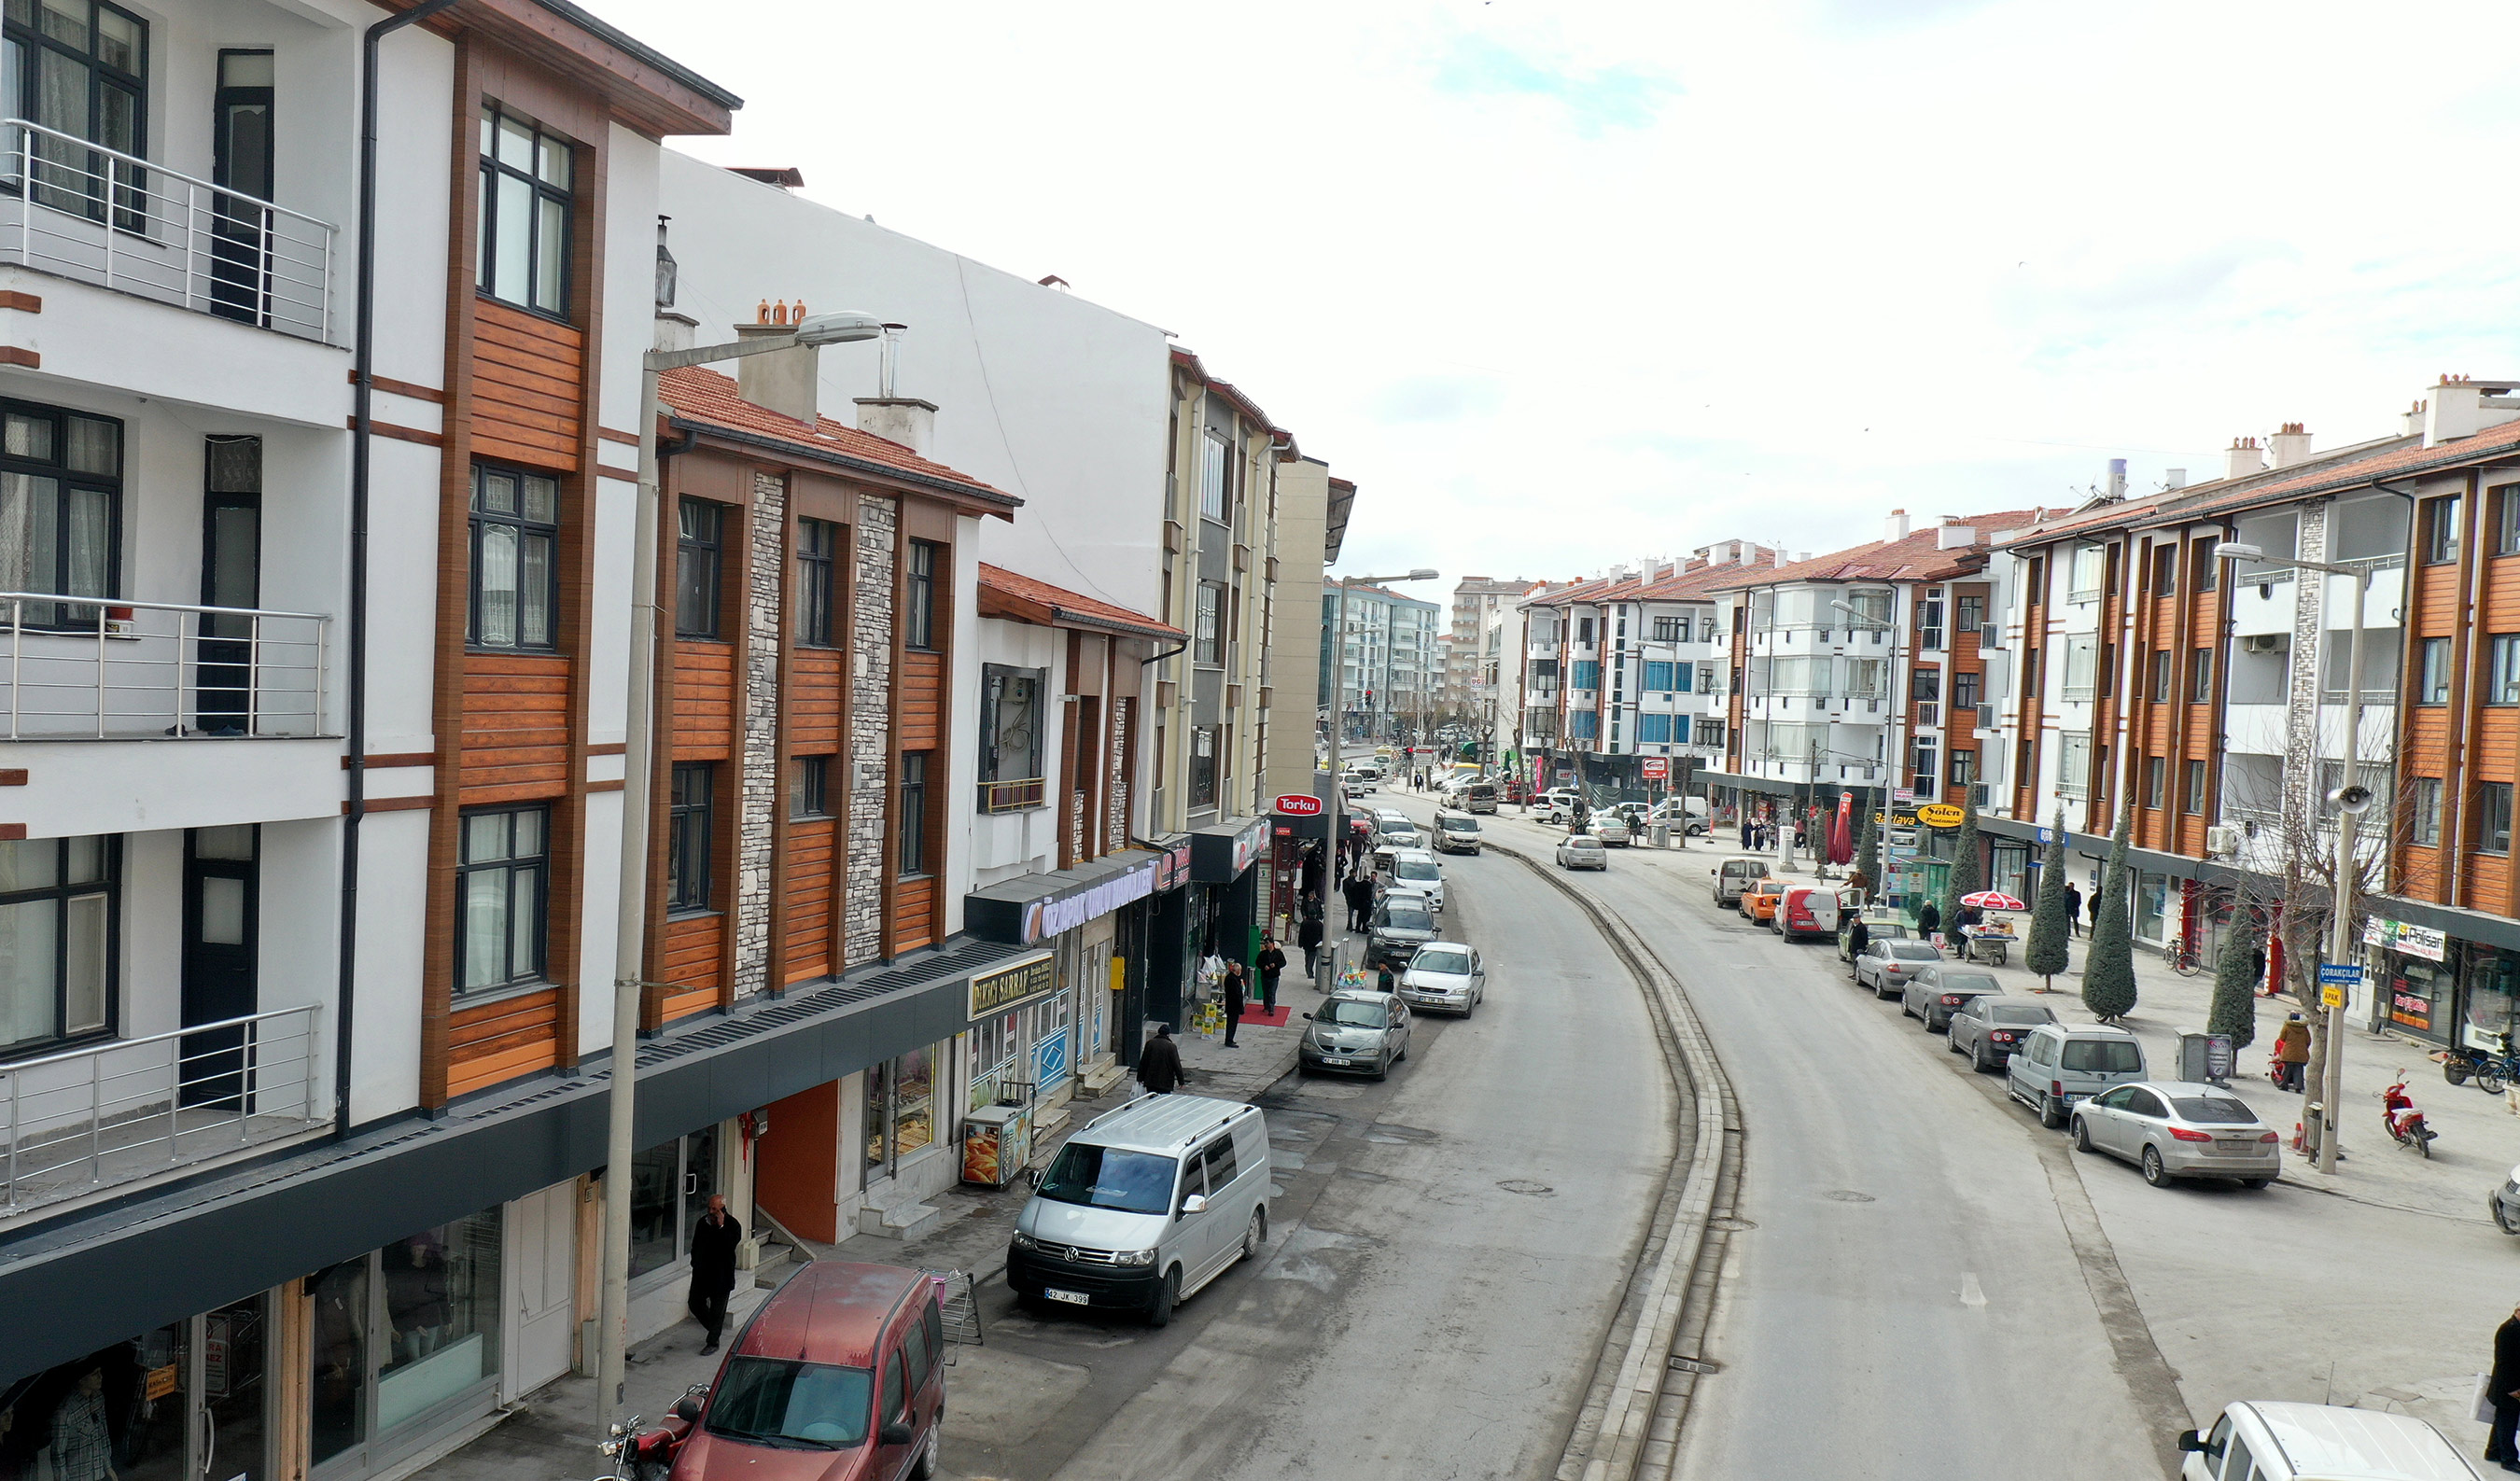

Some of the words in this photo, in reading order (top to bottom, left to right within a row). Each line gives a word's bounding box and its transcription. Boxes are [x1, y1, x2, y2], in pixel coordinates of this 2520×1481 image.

[1281, 798, 1315, 811] Torku
[1926, 807, 1960, 817] Şölen
[2409, 928, 2443, 949] Polisan
[2320, 968, 2359, 979] ÇORAKÇILAR
[999, 970, 1028, 1002] SARRAF
[1073, 1295, 1087, 1305] 399
